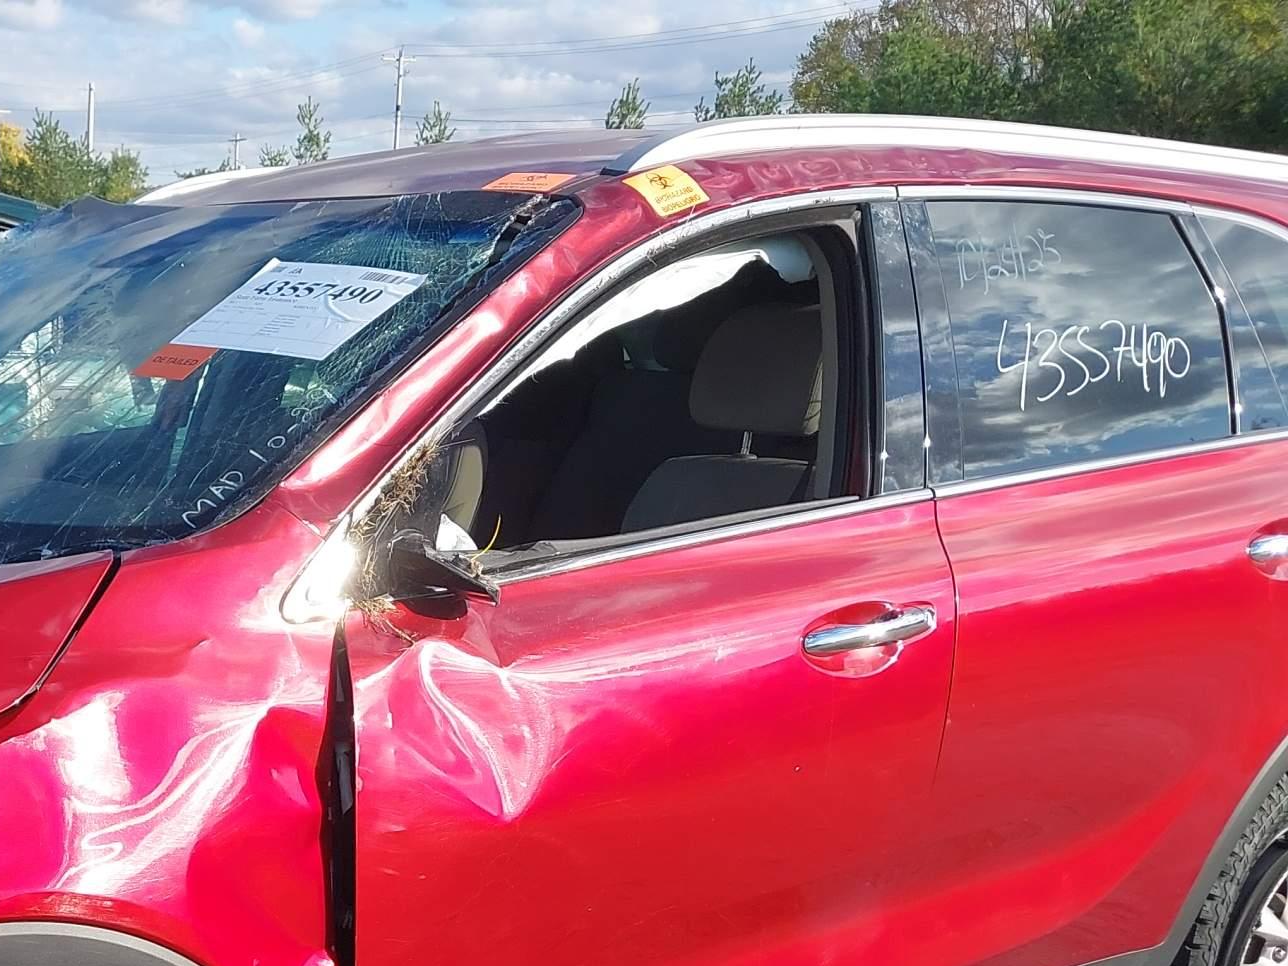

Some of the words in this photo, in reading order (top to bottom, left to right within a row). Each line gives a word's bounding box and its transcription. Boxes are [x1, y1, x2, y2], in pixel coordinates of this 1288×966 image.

[253, 280, 383, 304] 43557490
[153, 356, 200, 366] DETAILED
[997, 319, 1191, 412] 43557490
[181, 470, 244, 529] MAD
